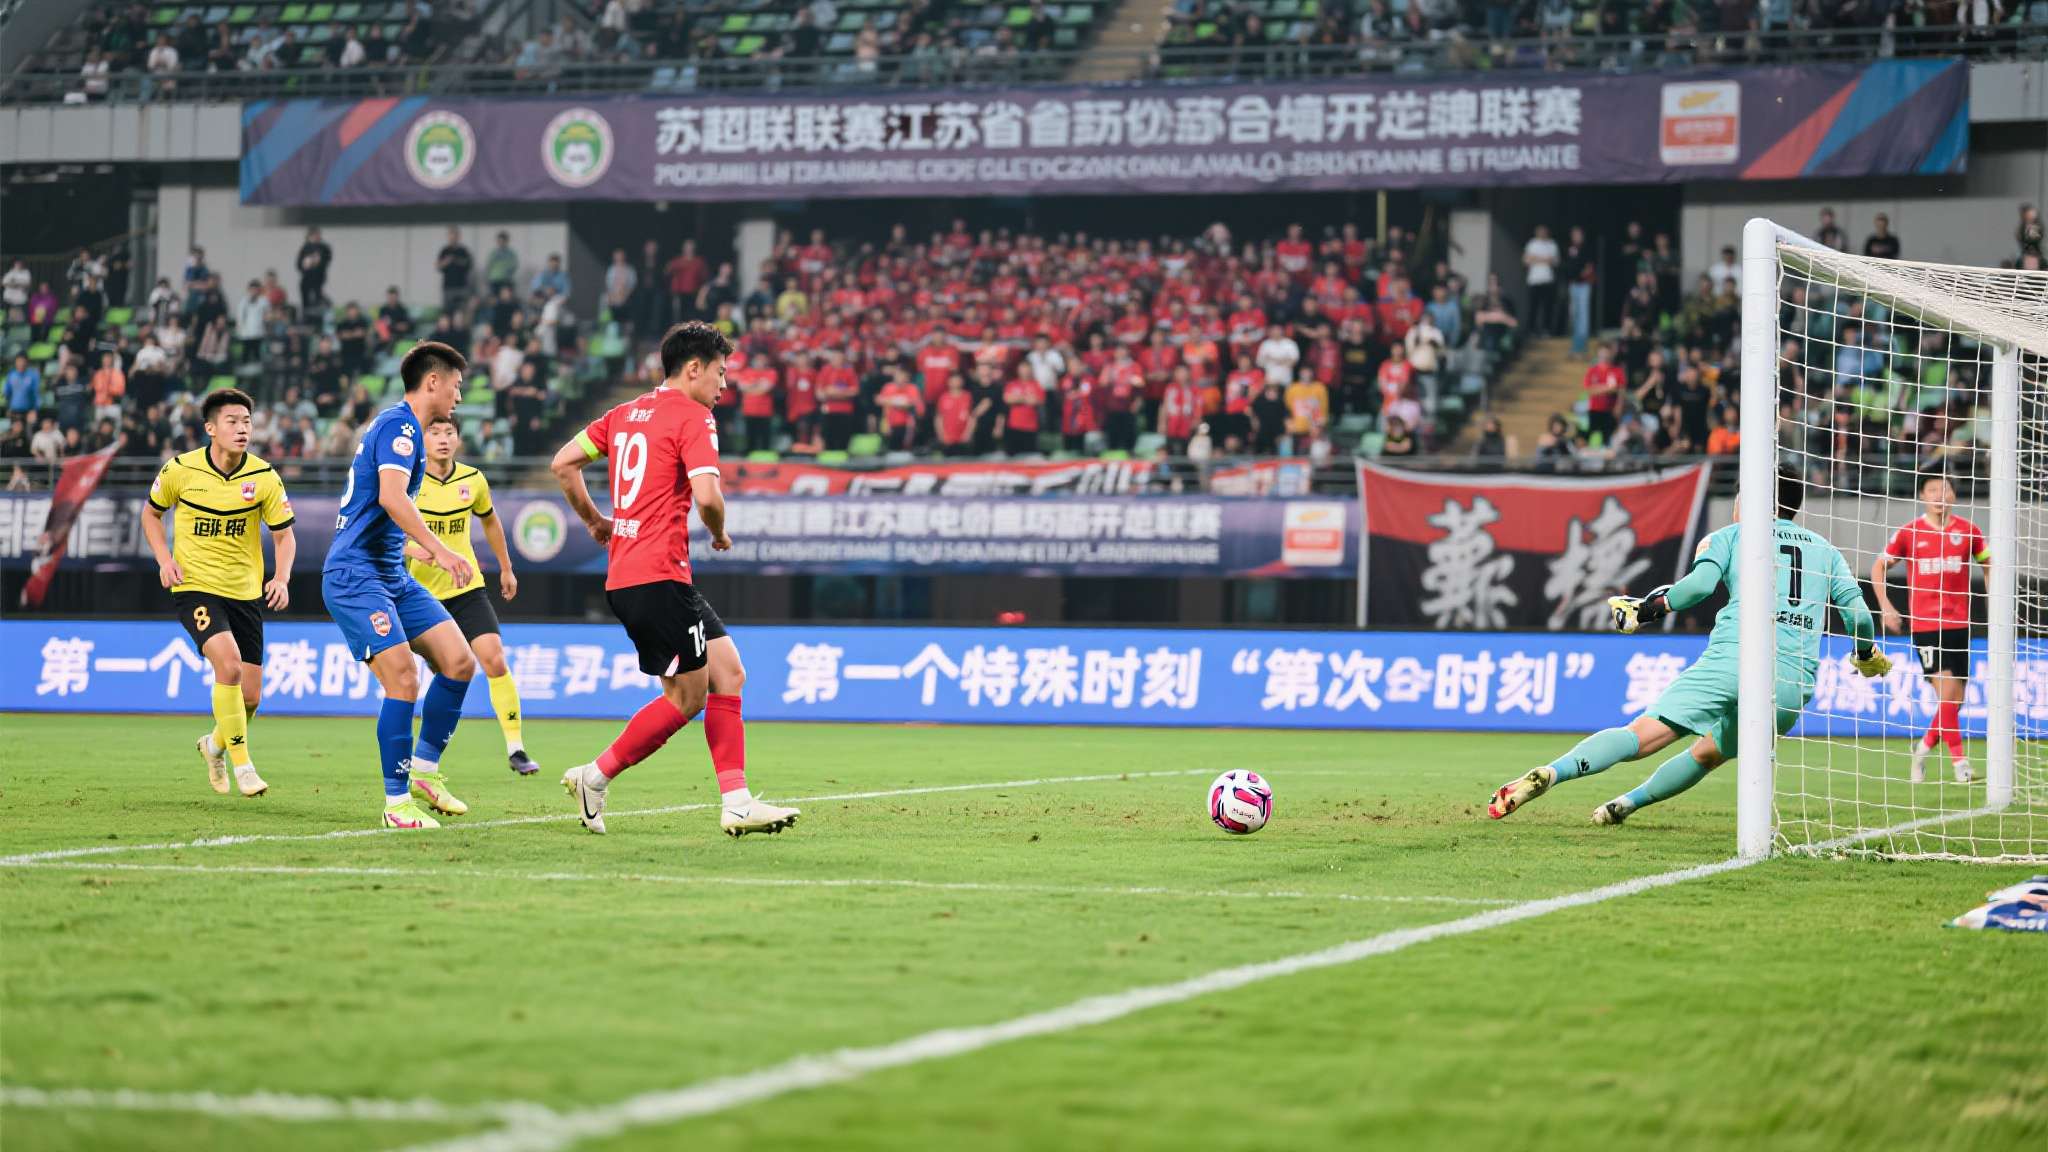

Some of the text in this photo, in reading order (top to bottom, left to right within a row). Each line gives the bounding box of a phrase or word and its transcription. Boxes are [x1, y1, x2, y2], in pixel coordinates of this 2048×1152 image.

[614, 432, 647, 510] 19
[193, 606, 211, 631] 8
[782, 642, 1202, 709] 第一个特殊时刻
